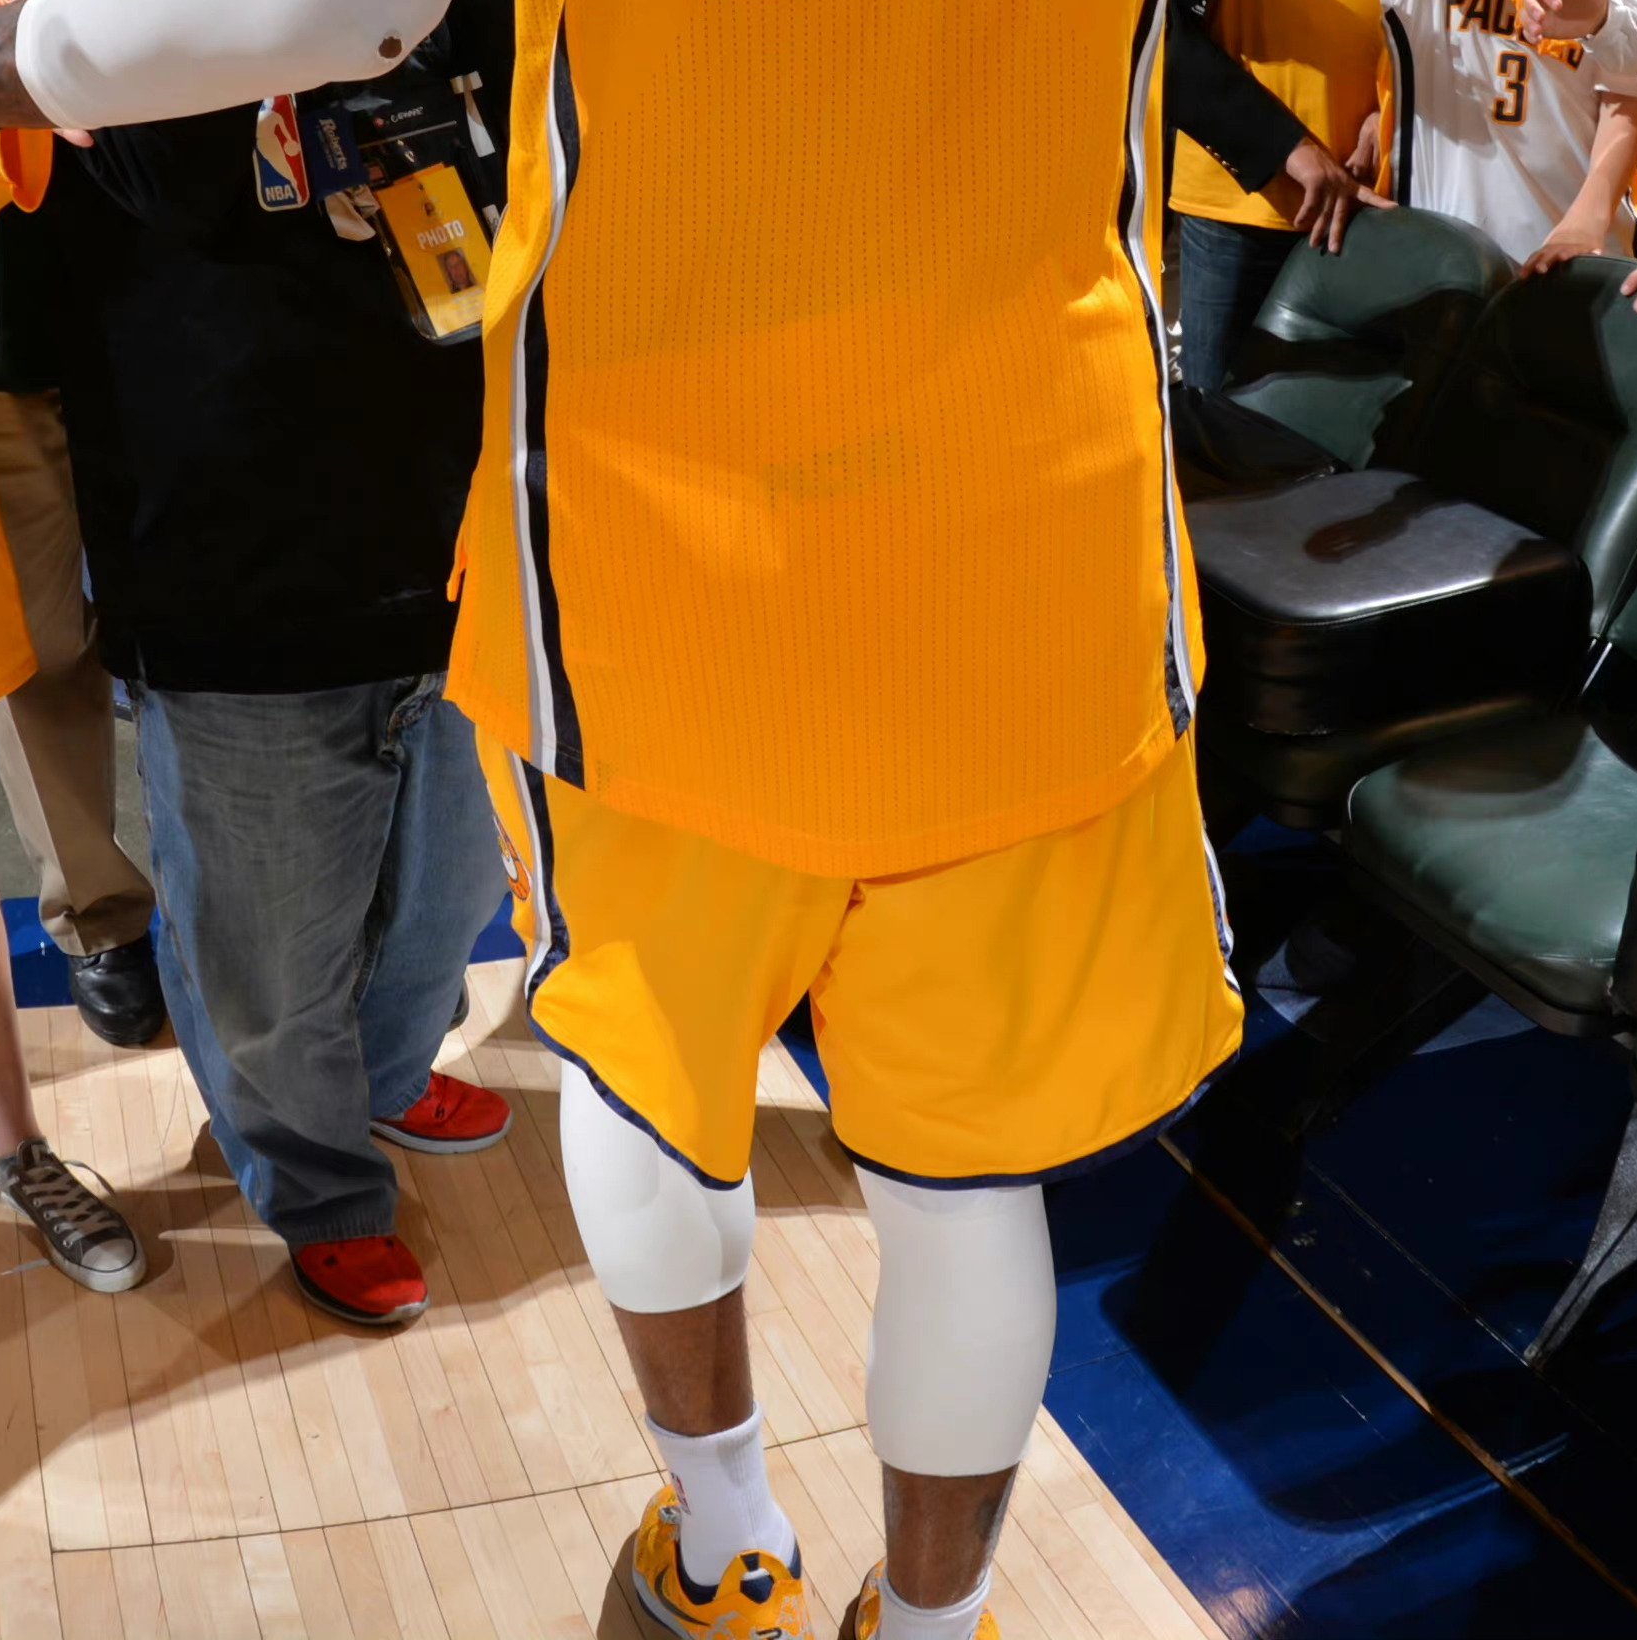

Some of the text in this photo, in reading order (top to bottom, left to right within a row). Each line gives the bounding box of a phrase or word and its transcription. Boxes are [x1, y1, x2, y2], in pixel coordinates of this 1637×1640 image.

[1491, 51, 1528, 125] 3
[265, 184, 295, 202] NBA
[417, 219, 464, 250] PHOTO
